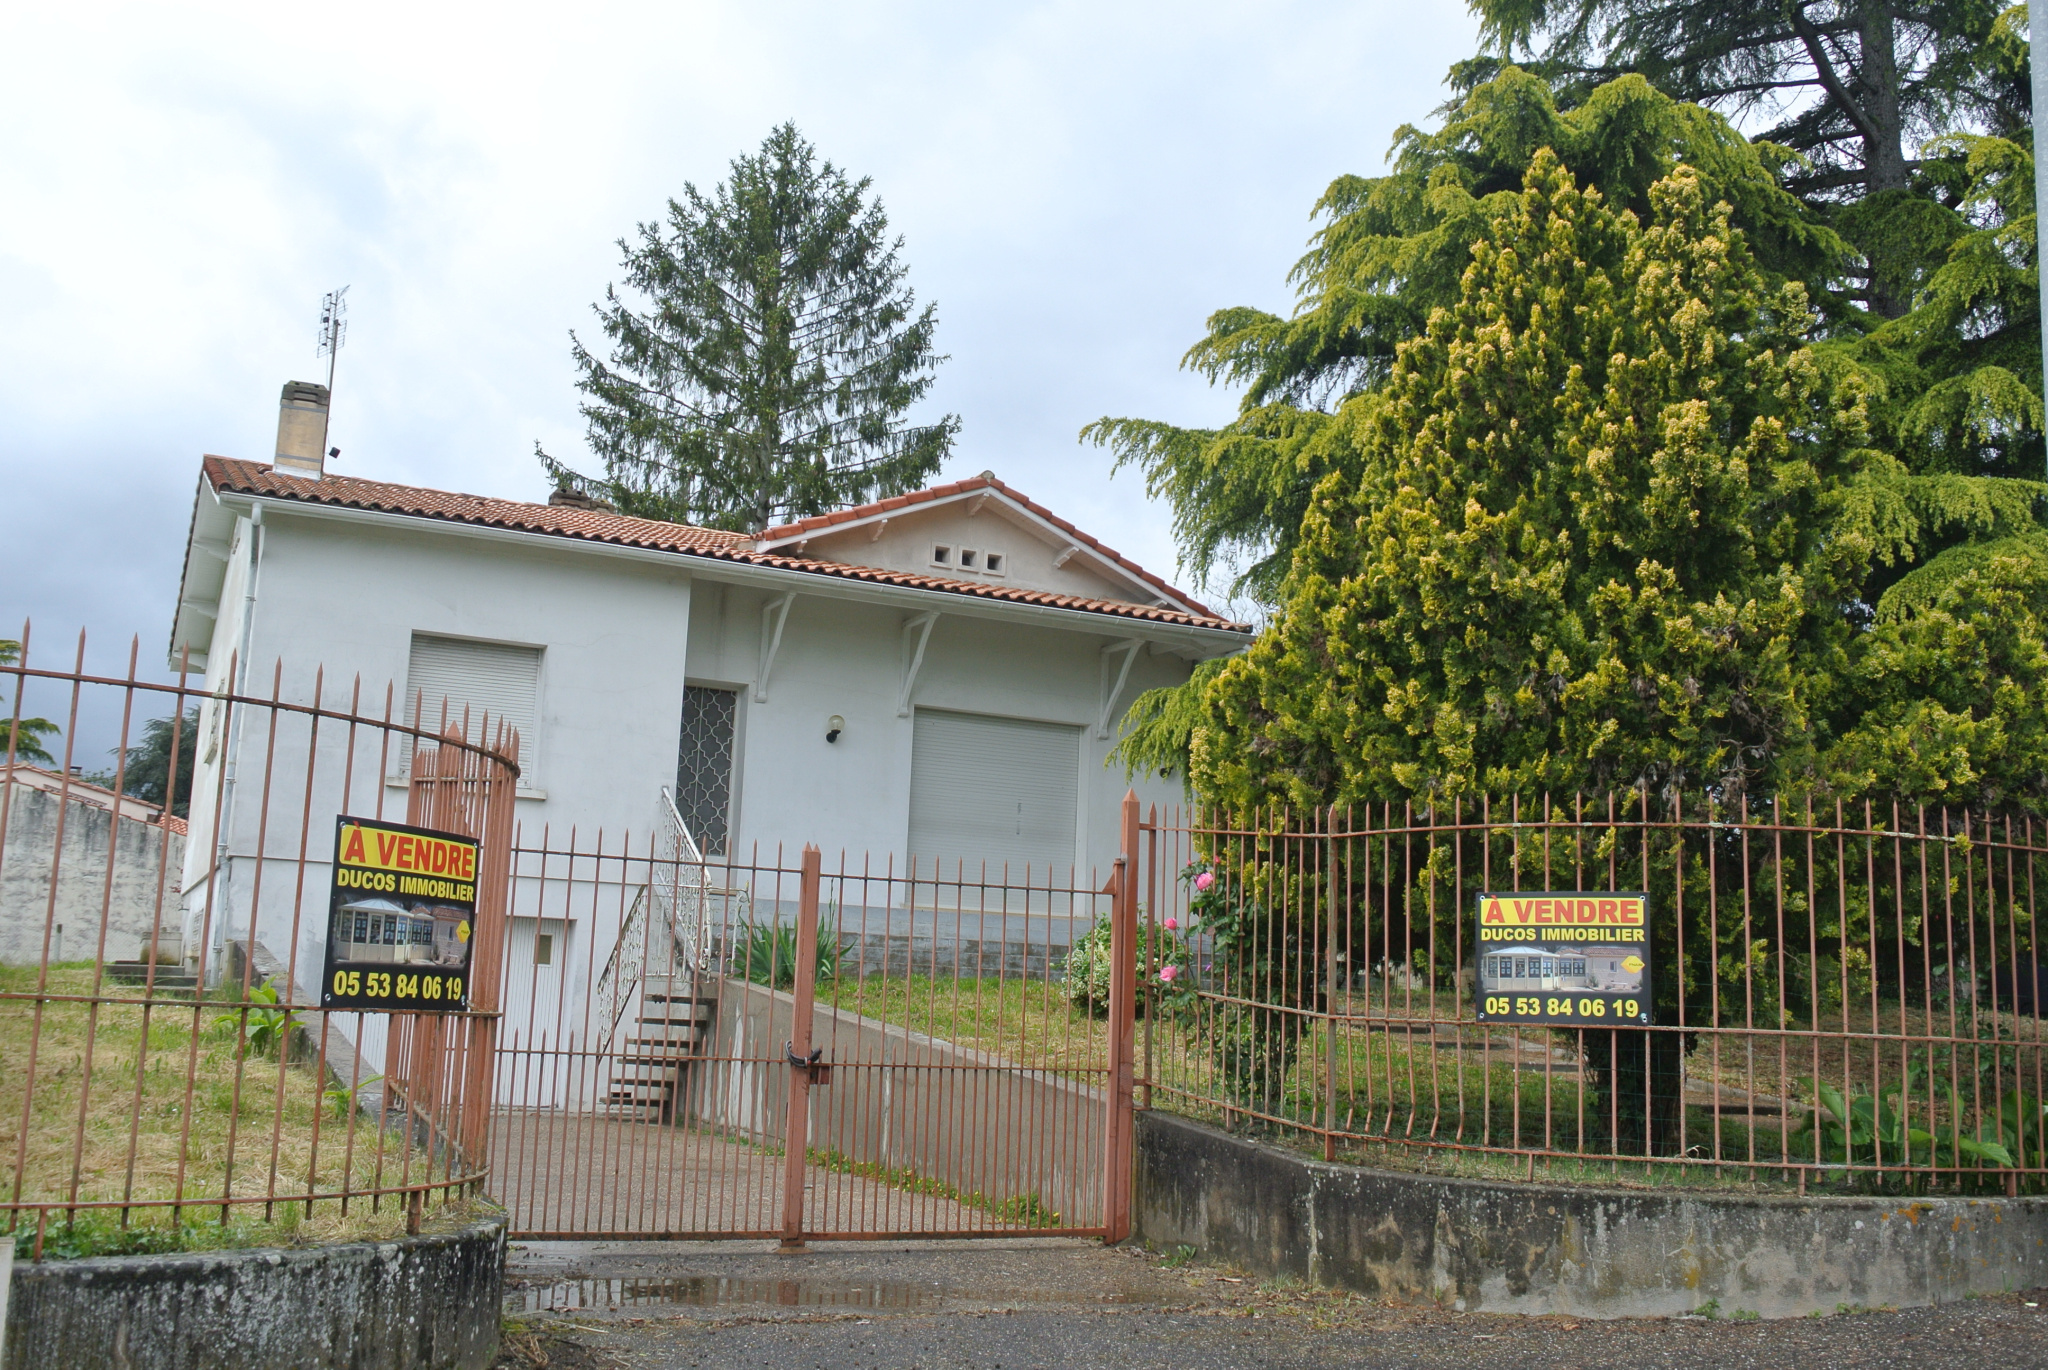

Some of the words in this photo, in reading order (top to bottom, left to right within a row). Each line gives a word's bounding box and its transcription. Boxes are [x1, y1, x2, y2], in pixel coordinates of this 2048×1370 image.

[344, 821, 366, 863] À
[377, 832, 473, 878] VENDRE
[338, 868, 396, 891] DUCOS
[400, 876, 474, 902] IMMOBILIER
[1485, 895, 1505, 923] À
[1513, 900, 1639, 923] VENDRE
[1481, 928, 1536, 941] DUCOS
[1541, 929, 1645, 941] IMMOBILIER
[333, 971, 360, 996] 05
[366, 972, 391, 997] 53
[396, 974, 418, 998] 84
[422, 975, 442, 999] 06
[446, 977, 462, 1000] 19
[1486, 997, 1510, 1015] 05
[1516, 998, 1540, 1016] 53
[1547, 998, 1573, 1016] 84
[1579, 999, 1605, 1017] 06
[1613, 1000, 1639, 1018] 19
